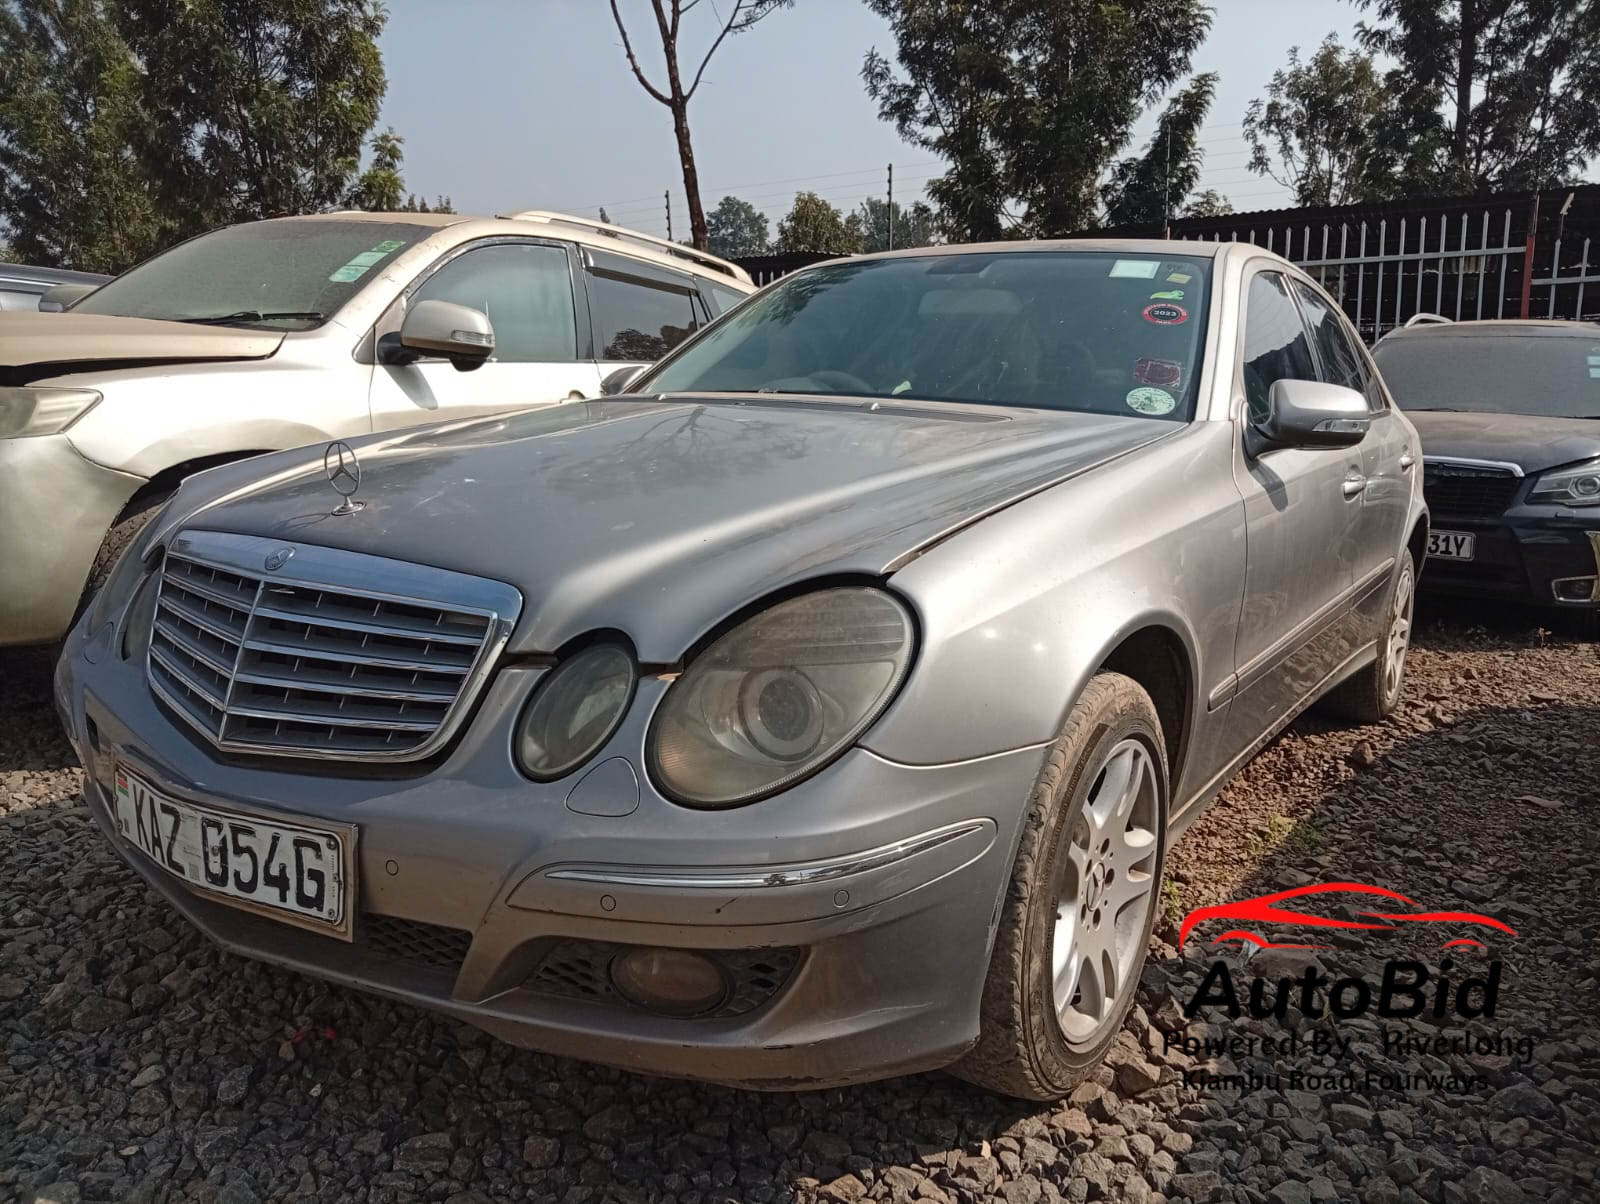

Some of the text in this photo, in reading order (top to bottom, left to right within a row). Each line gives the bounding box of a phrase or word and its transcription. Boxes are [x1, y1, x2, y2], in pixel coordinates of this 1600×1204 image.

[1428, 535, 1466, 556] 31Y
[132, 783, 325, 911] KAZ 054G
